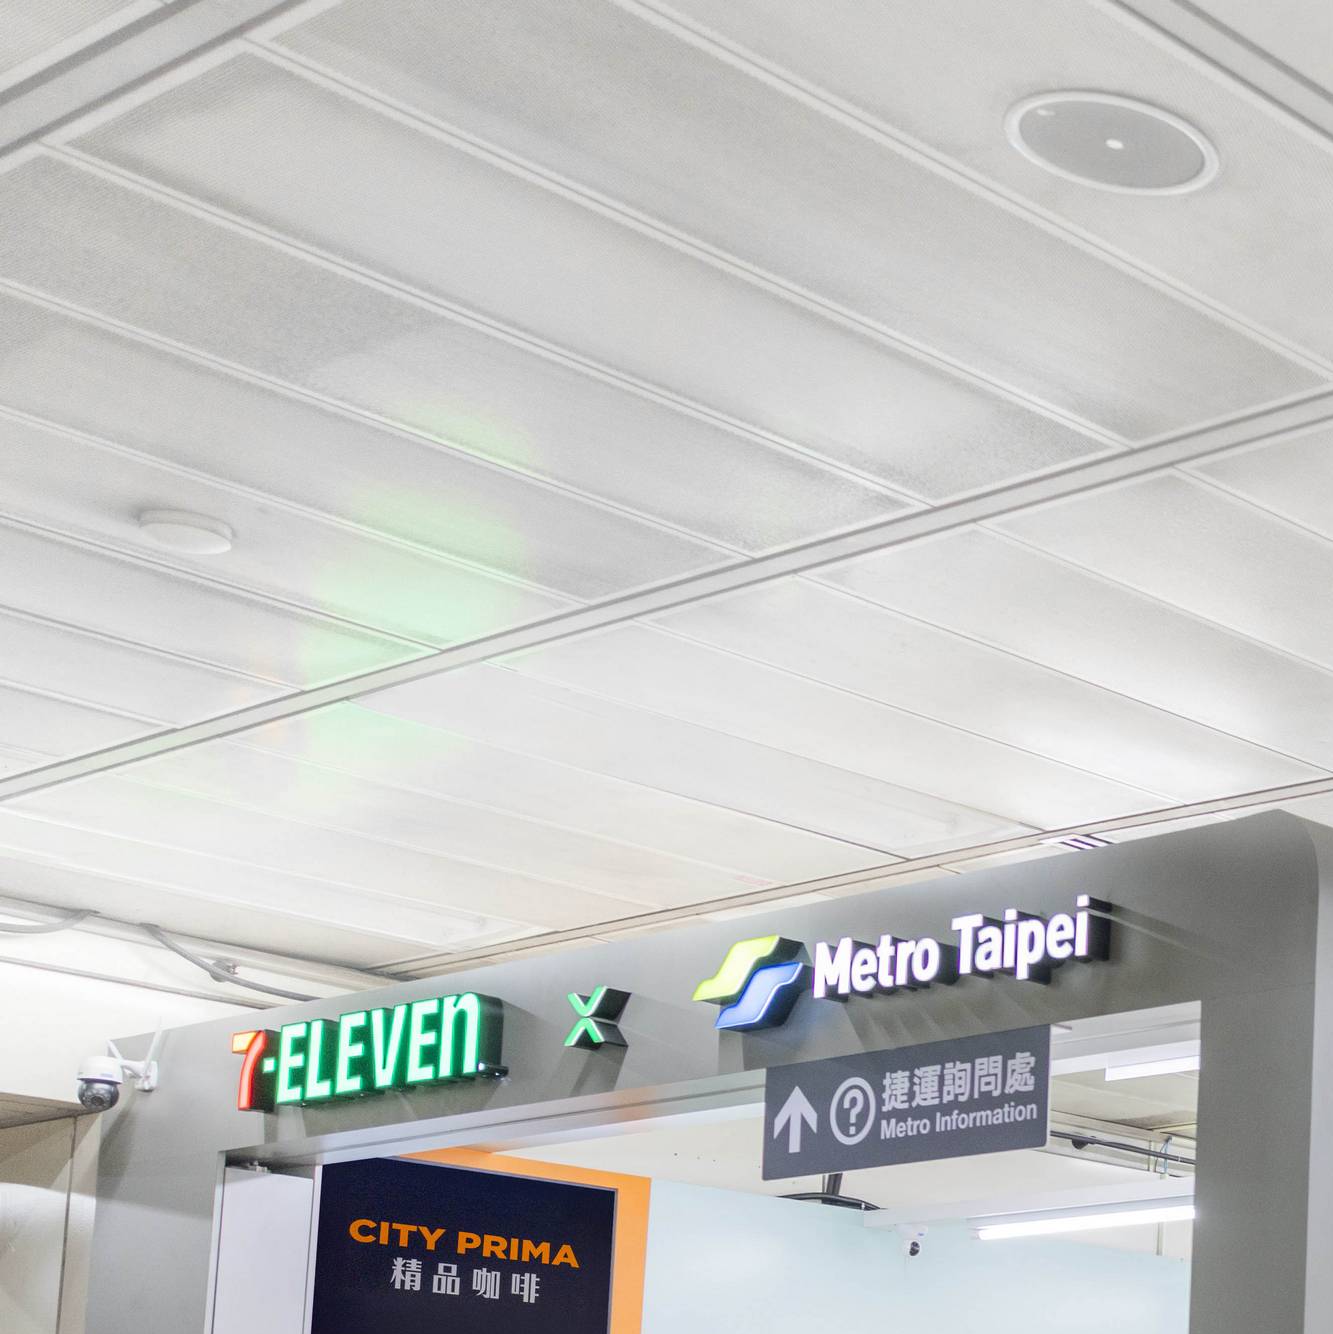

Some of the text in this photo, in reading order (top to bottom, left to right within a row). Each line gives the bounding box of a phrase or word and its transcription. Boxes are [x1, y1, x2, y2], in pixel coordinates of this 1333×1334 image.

[813, 933, 940, 998] Metro
[951, 895, 1092, 981] Taipei
[881, 1051, 1036, 1112] 捷運詢問處
[880, 1101, 1038, 1141] Metro Information
[348, 1218, 580, 1269] CITY PRIMA
[389, 1256, 541, 1305] 精品咖啡
